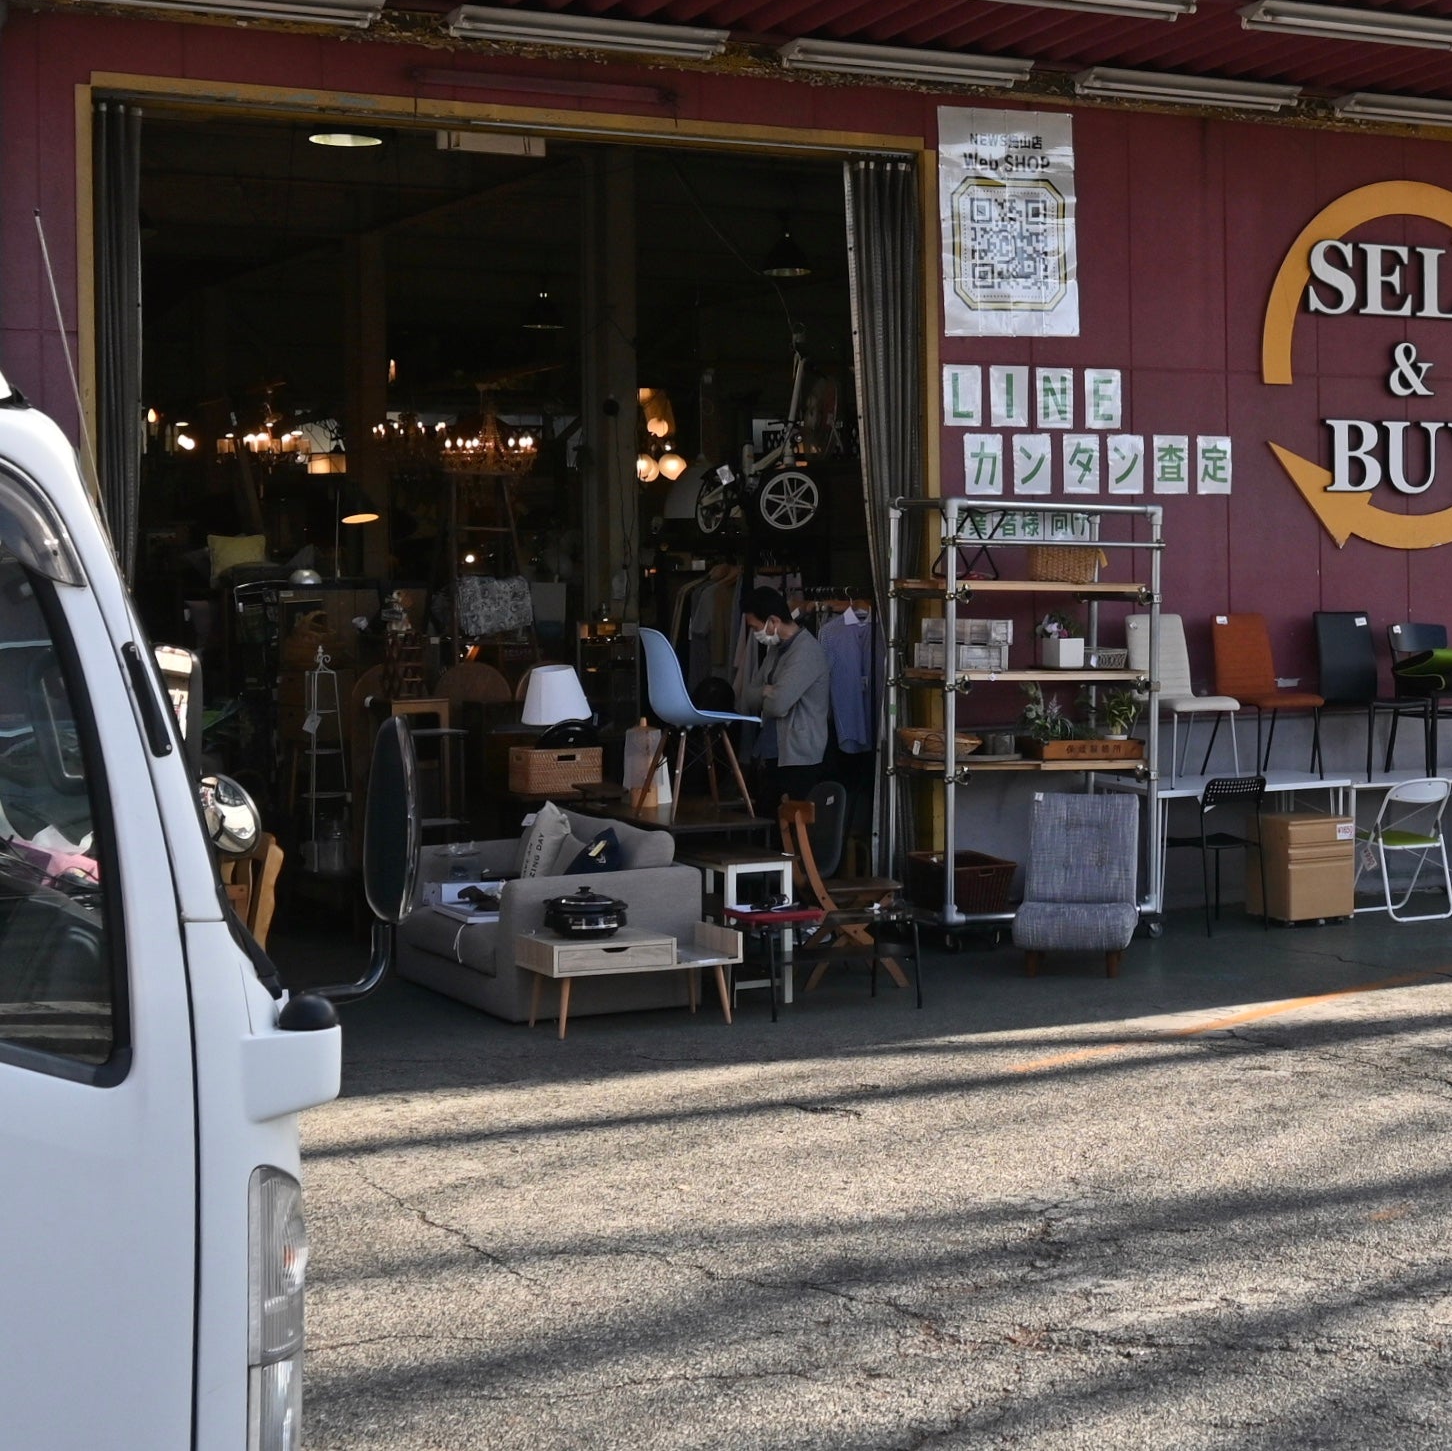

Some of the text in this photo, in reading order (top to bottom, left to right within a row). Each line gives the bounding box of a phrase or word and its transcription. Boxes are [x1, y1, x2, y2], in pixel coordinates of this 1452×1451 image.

[963, 152, 1051, 173] Web SHOP
[1387, 341, 1434, 397] &
[951, 372, 1114, 422] LINE
[970, 441, 1232, 486] カンタン査定
[536, 832, 545, 851] DAY
